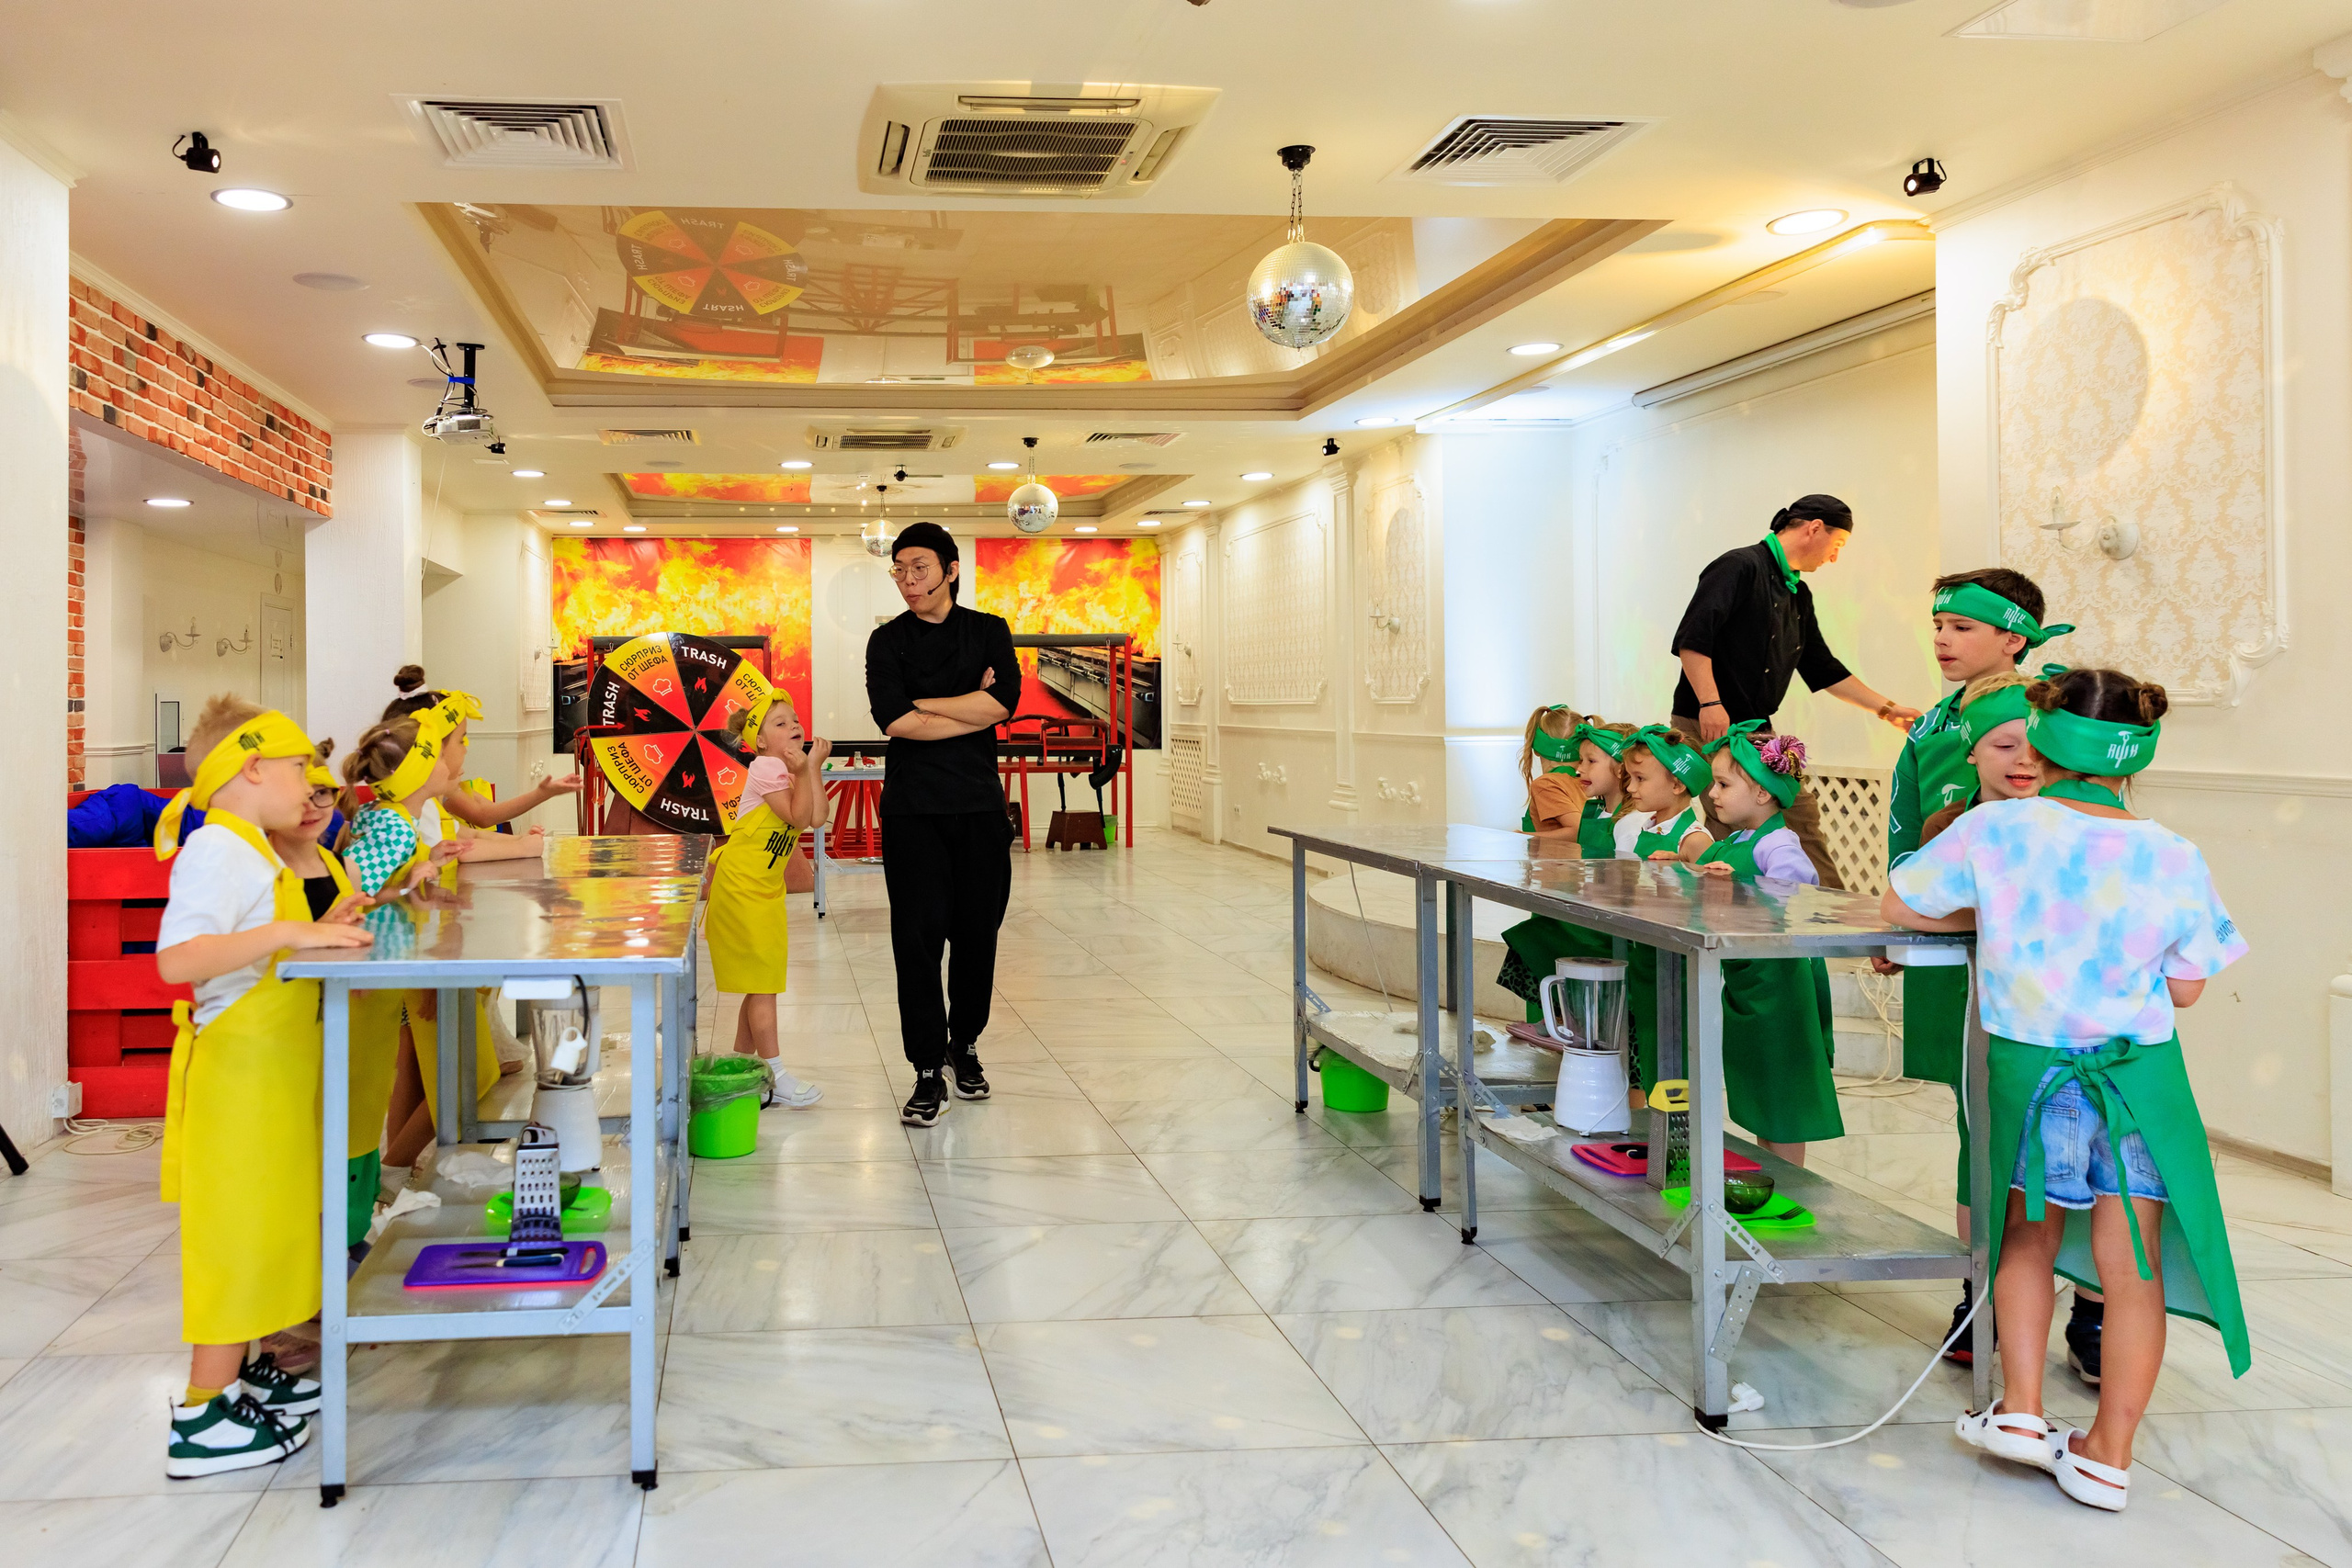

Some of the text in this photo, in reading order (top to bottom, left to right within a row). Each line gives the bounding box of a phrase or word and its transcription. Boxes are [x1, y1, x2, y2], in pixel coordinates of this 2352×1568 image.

[619, 645, 662, 672] СЮРПРИЗ
[628, 655, 669, 681] ОТ ШЕФА
[681, 646, 728, 670] TRASH
[735, 678, 749, 690] ОТ
[603, 681, 621, 727] TRASH
[607, 746, 645, 794] СЮРПРИЗ
[617, 741, 653, 787] ОТ ШЕФА
[660, 797, 710, 821] TRASH
